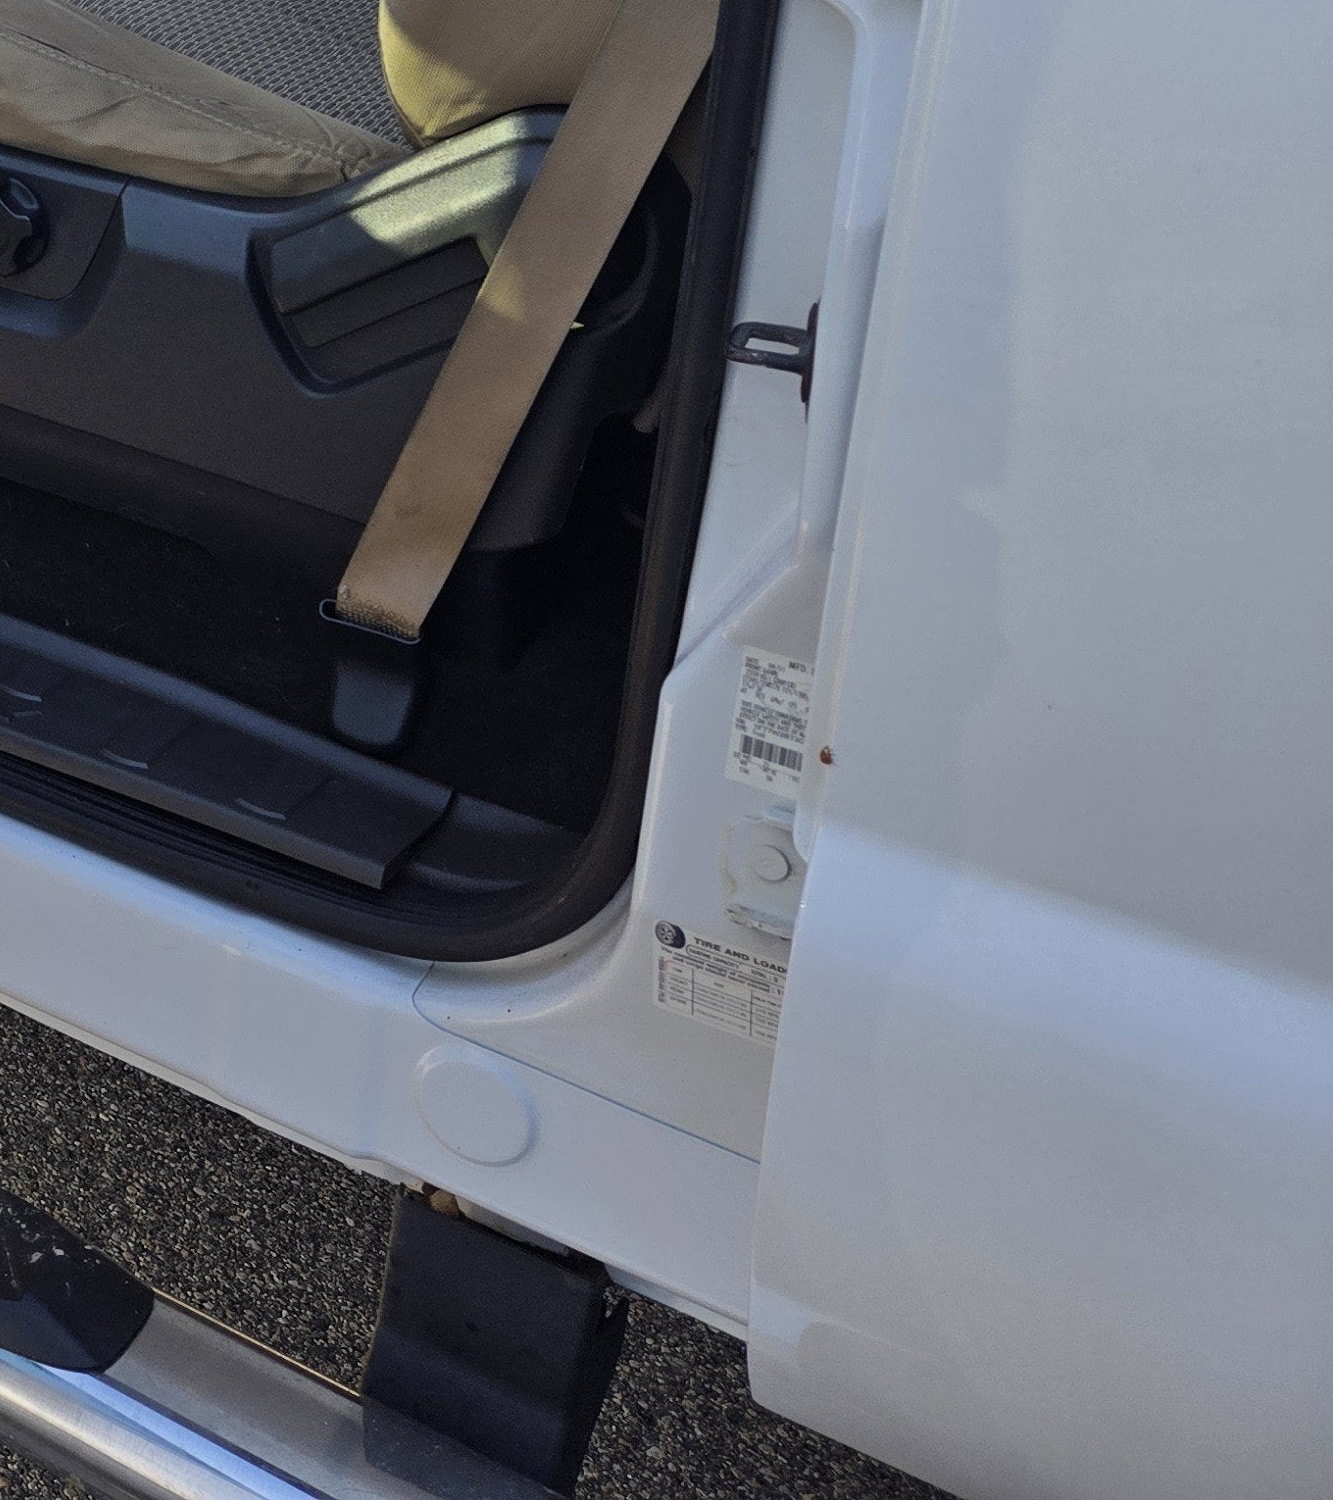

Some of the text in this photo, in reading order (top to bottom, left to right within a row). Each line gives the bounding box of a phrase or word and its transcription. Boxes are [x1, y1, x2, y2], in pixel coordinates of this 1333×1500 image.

[693, 936, 788, 974] TIRE AND LOAD
